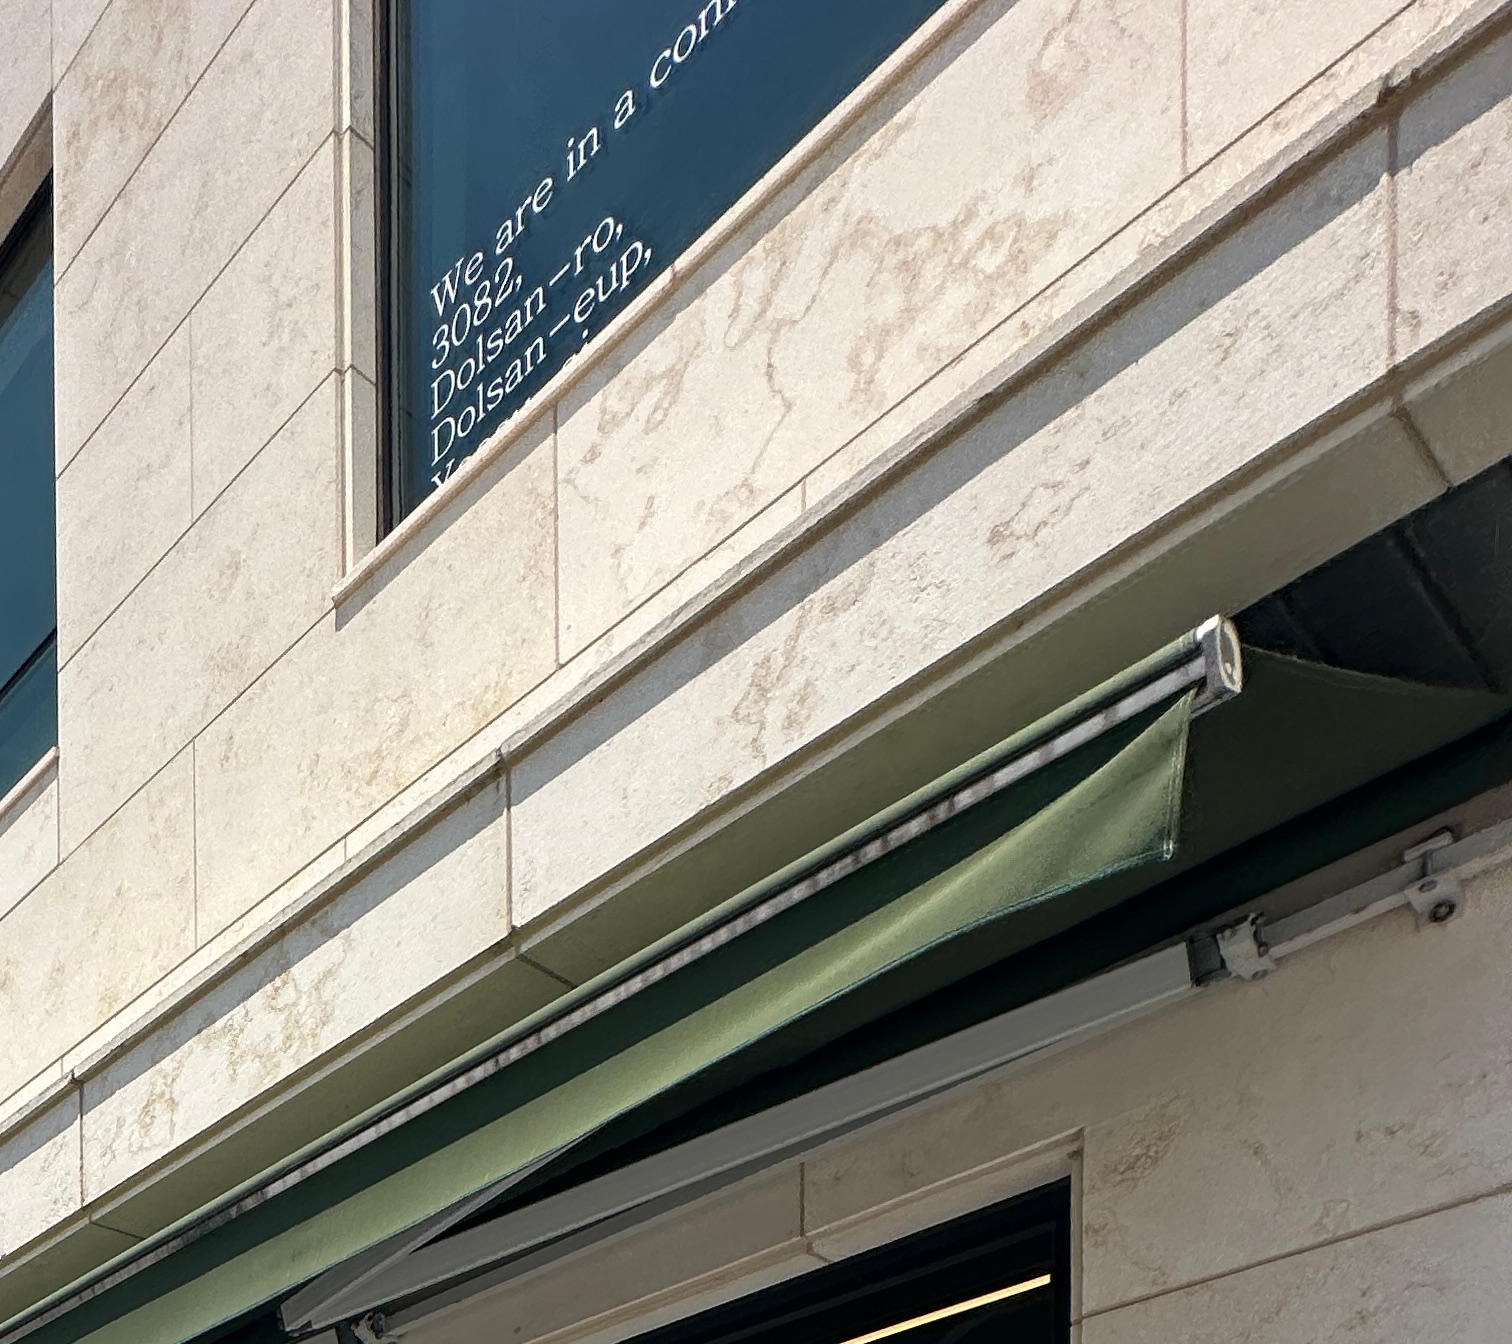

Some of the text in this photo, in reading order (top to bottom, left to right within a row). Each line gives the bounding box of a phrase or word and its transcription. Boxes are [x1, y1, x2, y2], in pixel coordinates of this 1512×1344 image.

[431, 0, 737, 318] We are in a con
[432, 257, 524, 369] 3082,
